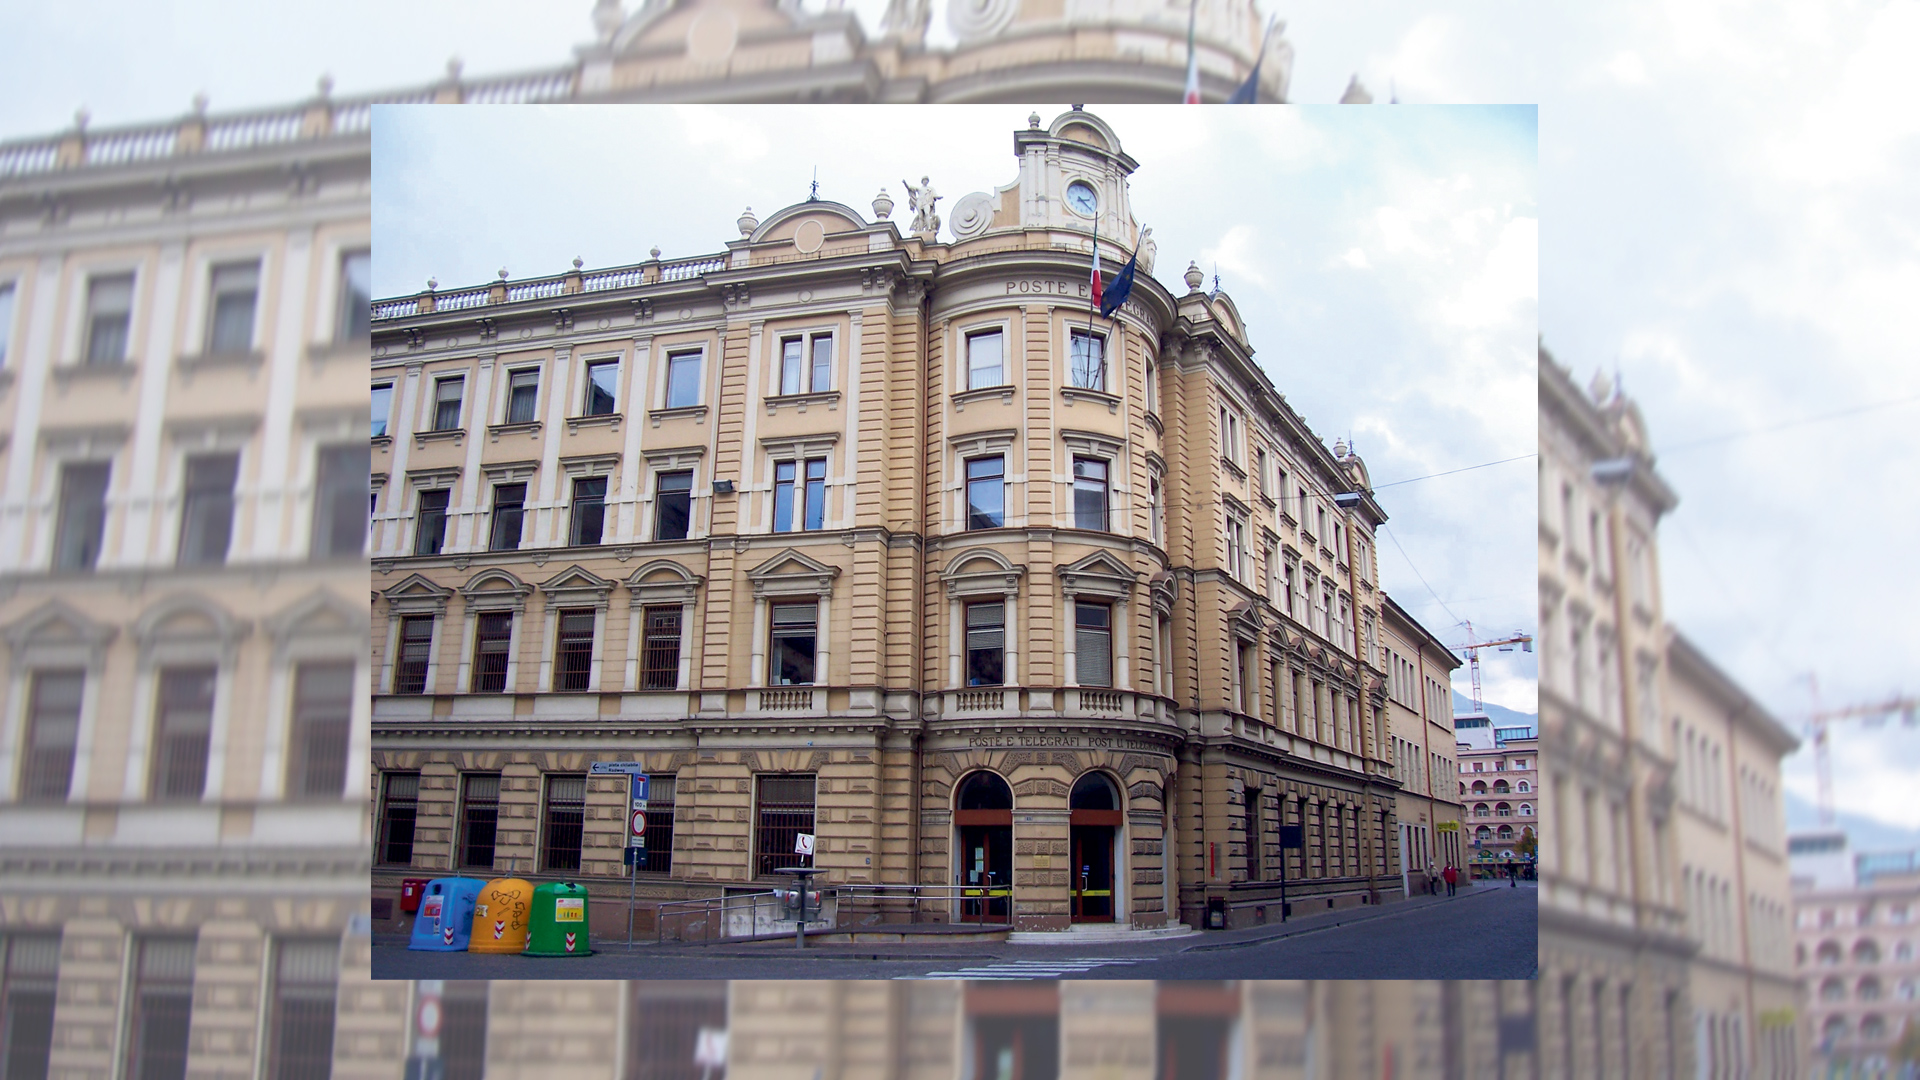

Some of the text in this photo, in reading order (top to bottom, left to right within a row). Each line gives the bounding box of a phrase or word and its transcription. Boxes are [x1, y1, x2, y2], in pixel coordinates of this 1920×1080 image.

[1006, 280, 1068, 295] POSTE
[1078, 284, 1088, 298] E
[969, 736, 1002, 747] POSTE
[1006, 736, 1014, 747] E
[1018, 736, 1080, 747] TELEGRAFI
[1088, 737, 1113, 748] POST
